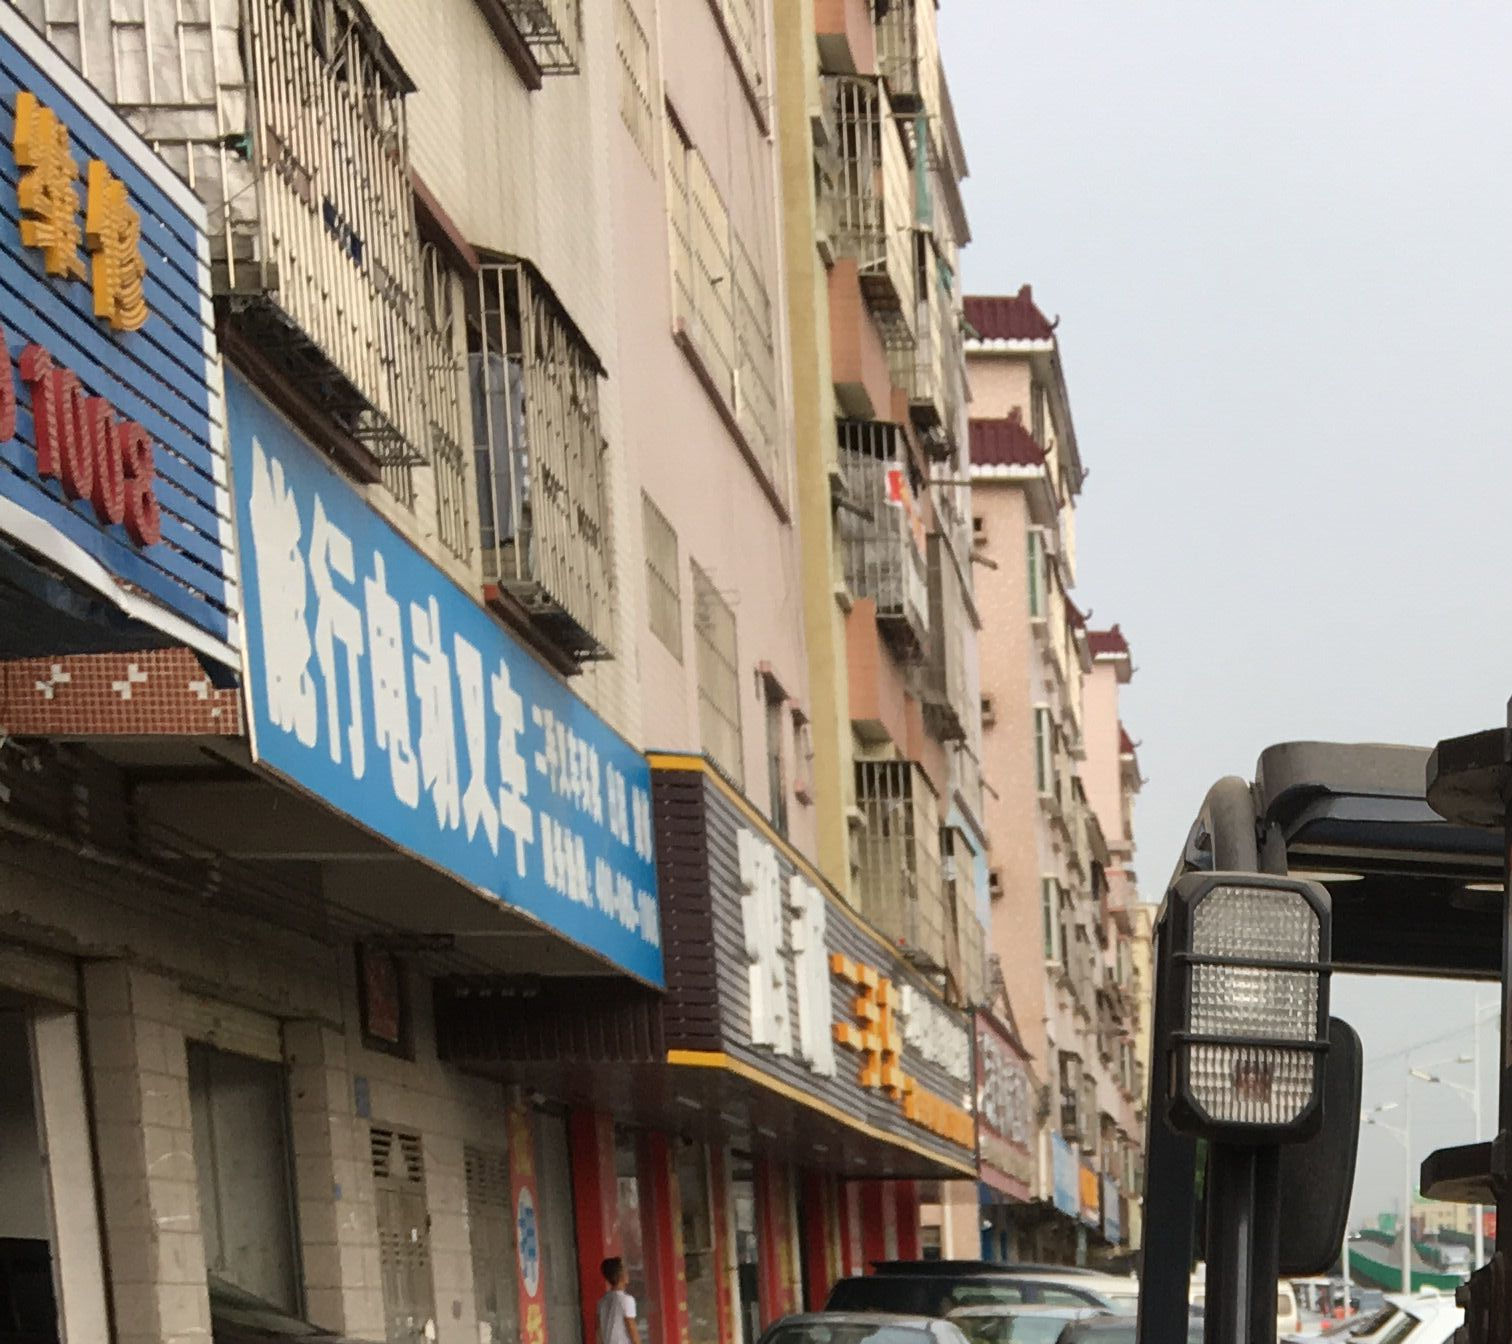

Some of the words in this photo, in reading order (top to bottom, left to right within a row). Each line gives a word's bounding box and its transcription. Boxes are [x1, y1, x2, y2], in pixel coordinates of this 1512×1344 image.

[249, 434, 534, 879] 能行电动叉车
